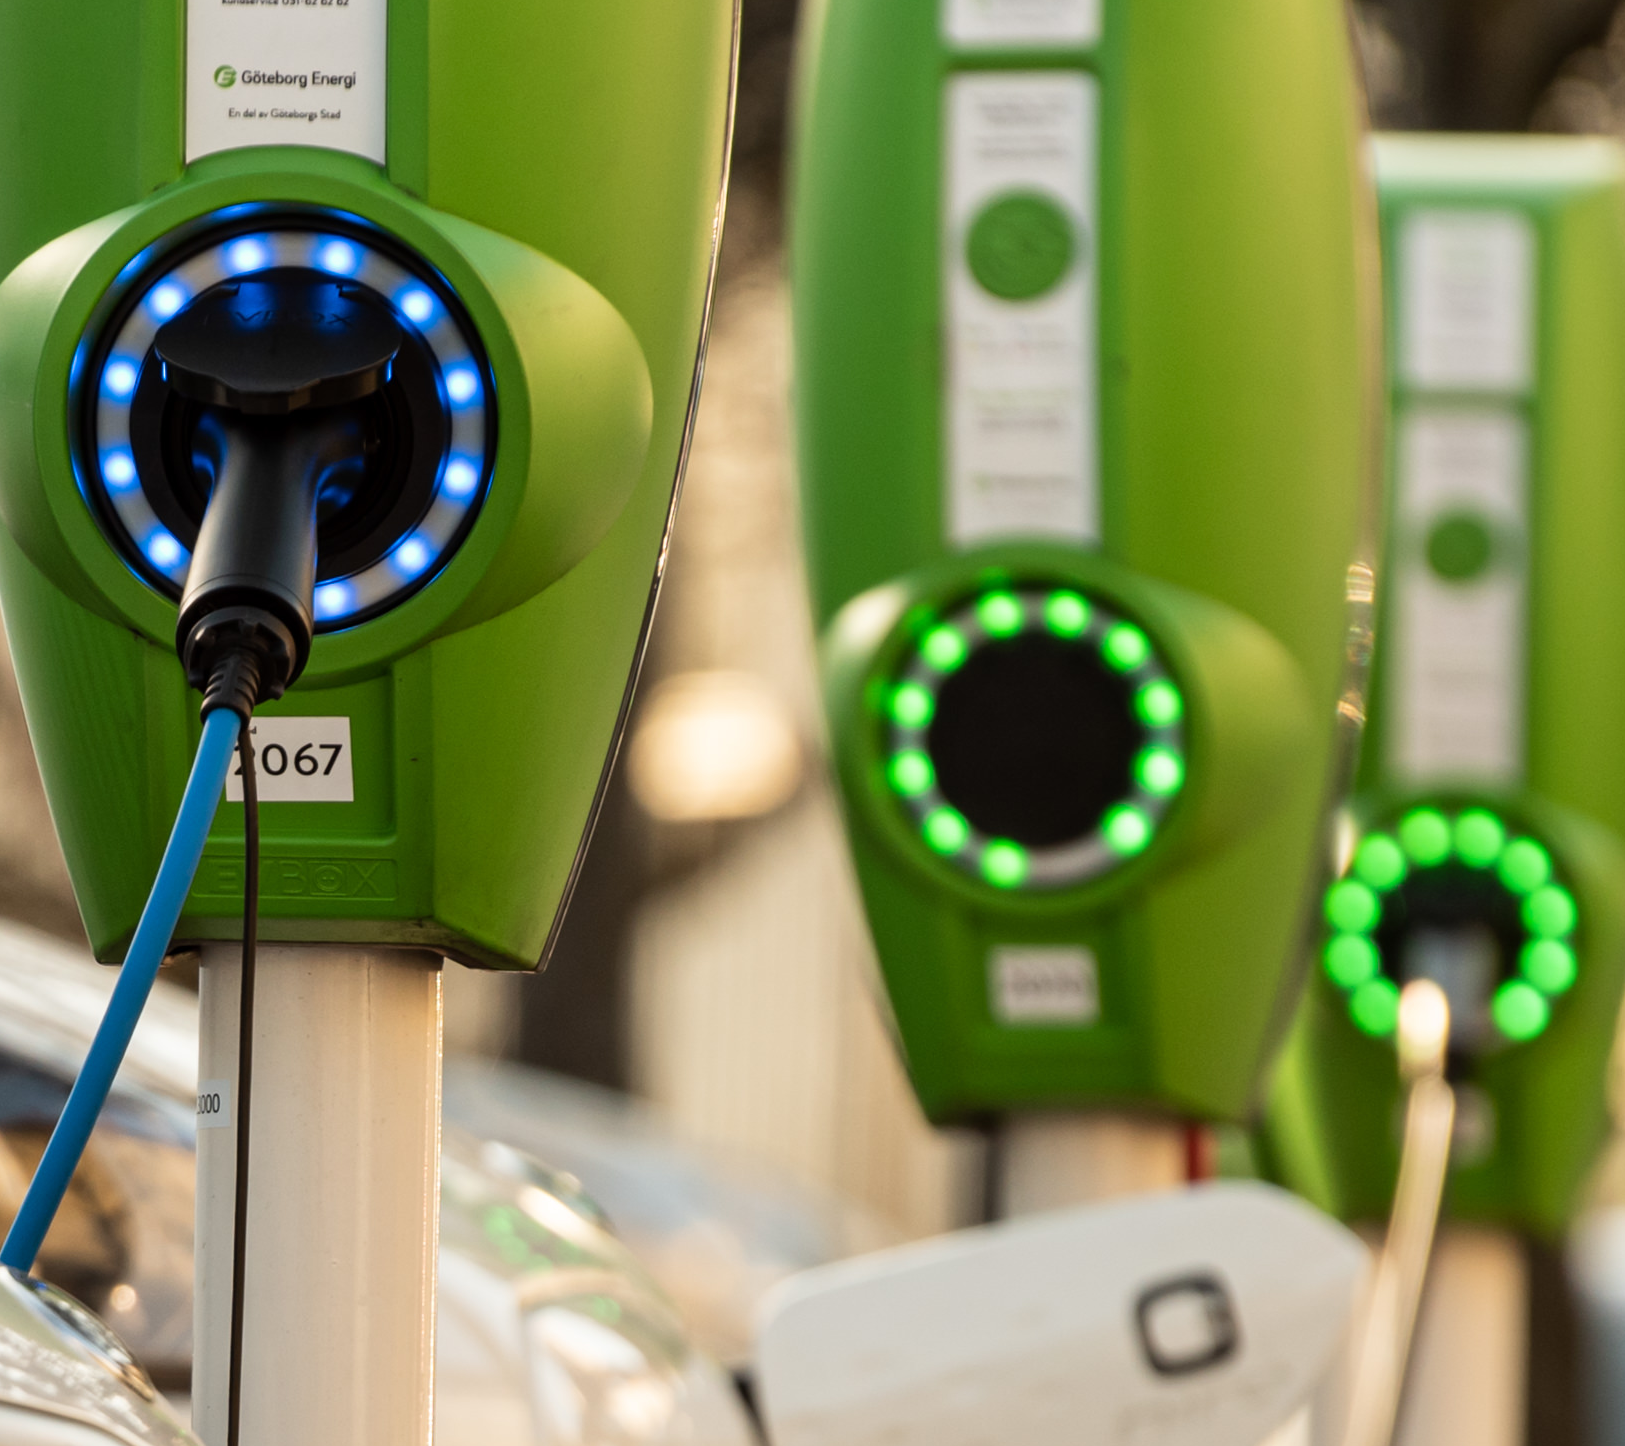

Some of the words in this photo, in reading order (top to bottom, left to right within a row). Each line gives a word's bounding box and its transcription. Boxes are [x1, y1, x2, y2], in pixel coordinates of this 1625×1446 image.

[242, 70, 307, 88] Göteborg
[312, 71, 356, 89] Energi
[228, 108, 241, 118] En
[243, 108, 256, 118] del
[270, 108, 318, 121] Göteborgs
[320, 109, 341, 120] Stad
